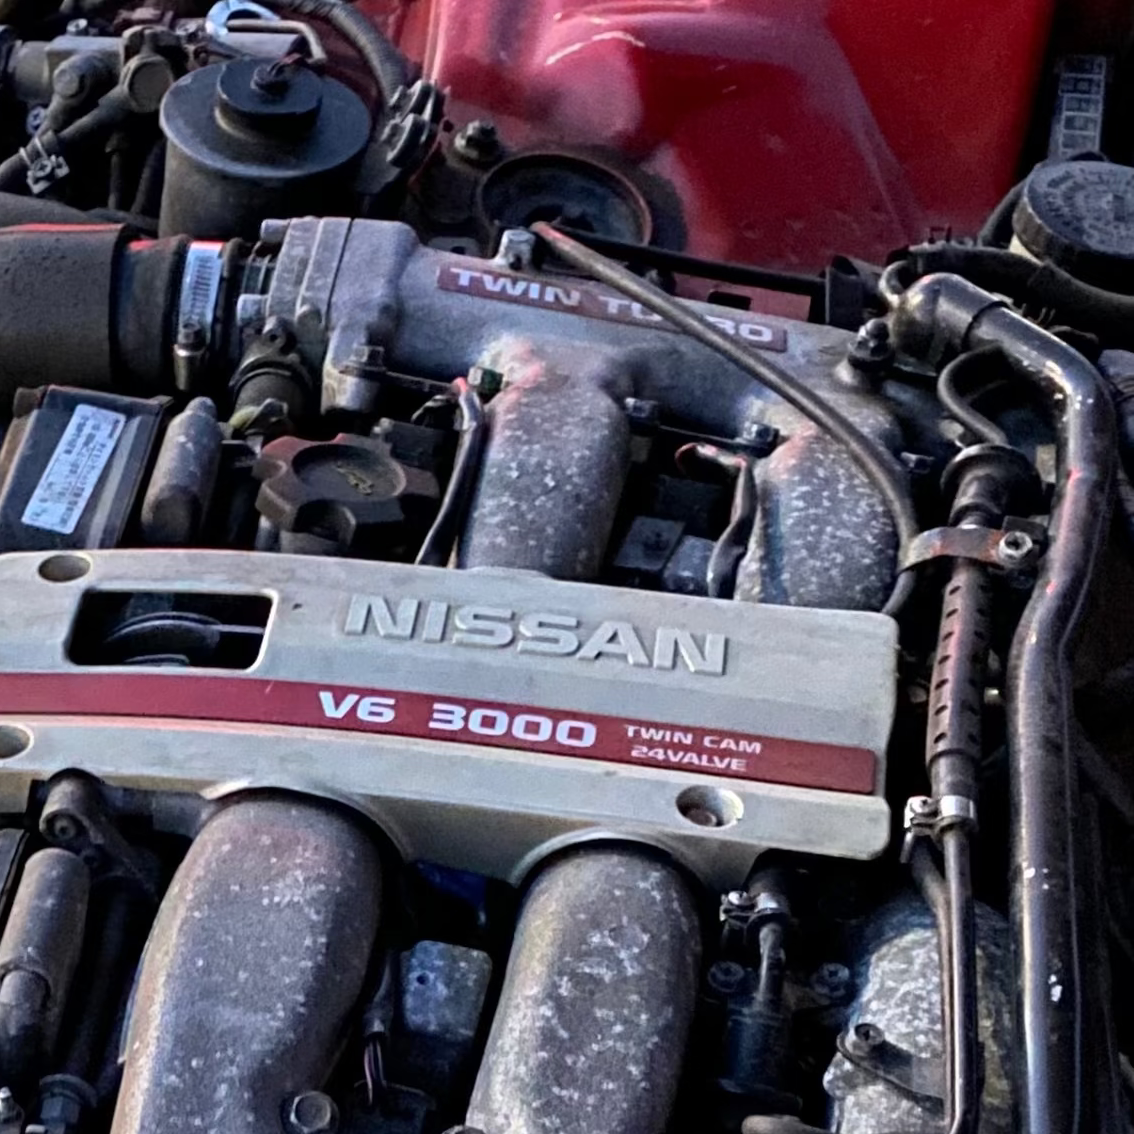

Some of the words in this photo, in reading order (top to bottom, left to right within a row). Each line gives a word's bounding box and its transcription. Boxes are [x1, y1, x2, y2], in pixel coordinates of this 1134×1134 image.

[450, 266, 581, 307] TWIN
[344, 594, 730, 676] NISSAN
[318, 691, 396, 723] V6
[429, 703, 597, 748] 3000
[625, 724, 693, 746] TWIN
[703, 735, 762, 755] CAM
[631, 745, 748, 772] 24VALVE
